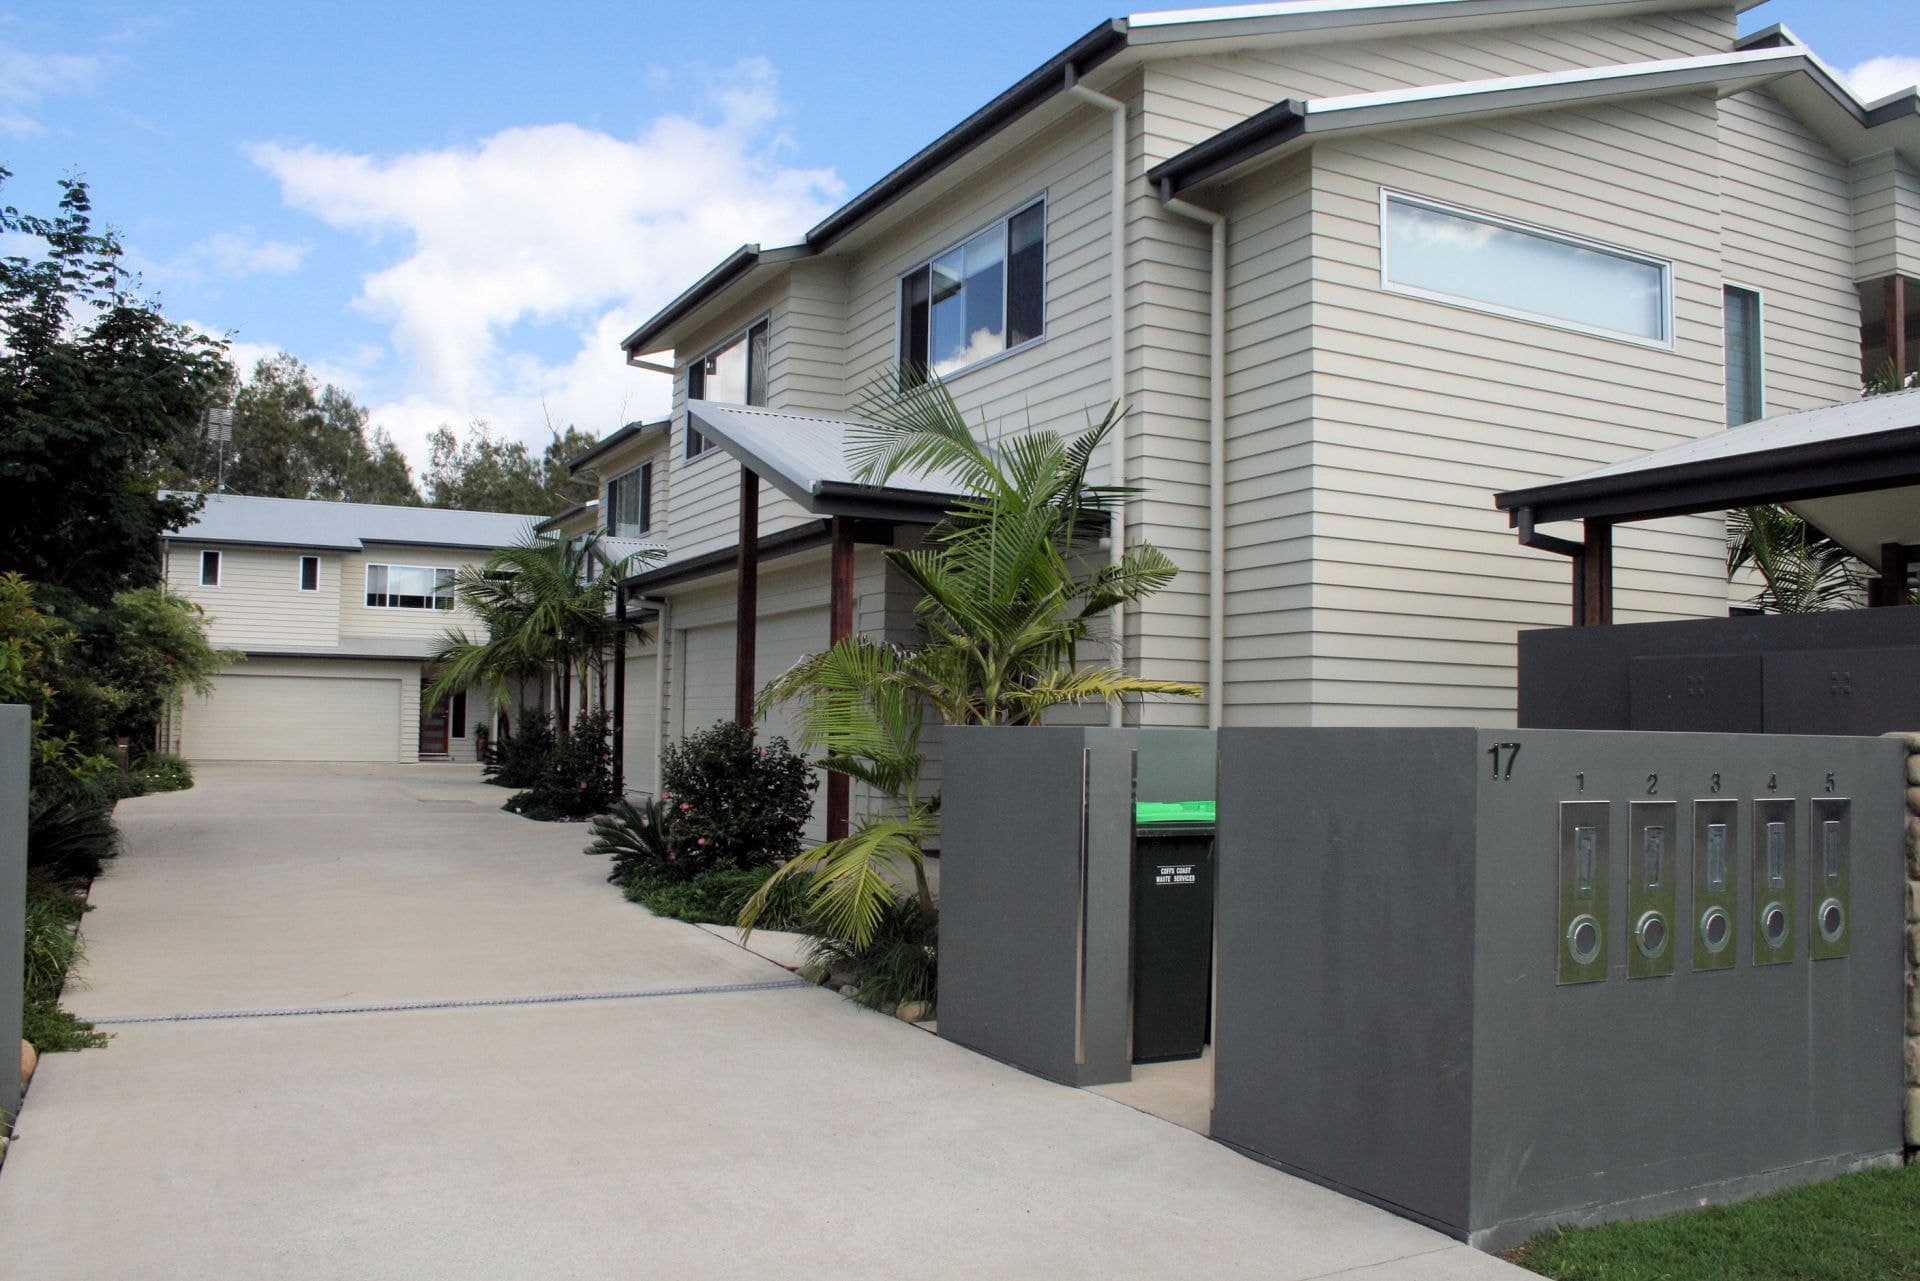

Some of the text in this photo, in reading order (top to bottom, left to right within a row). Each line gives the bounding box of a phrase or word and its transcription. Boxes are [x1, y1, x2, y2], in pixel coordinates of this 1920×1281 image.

[1487, 743, 1521, 780] 17
[1575, 770, 1835, 795] 1 2 3 4 5
[1156, 874, 1195, 883] WASTE SERVICES
